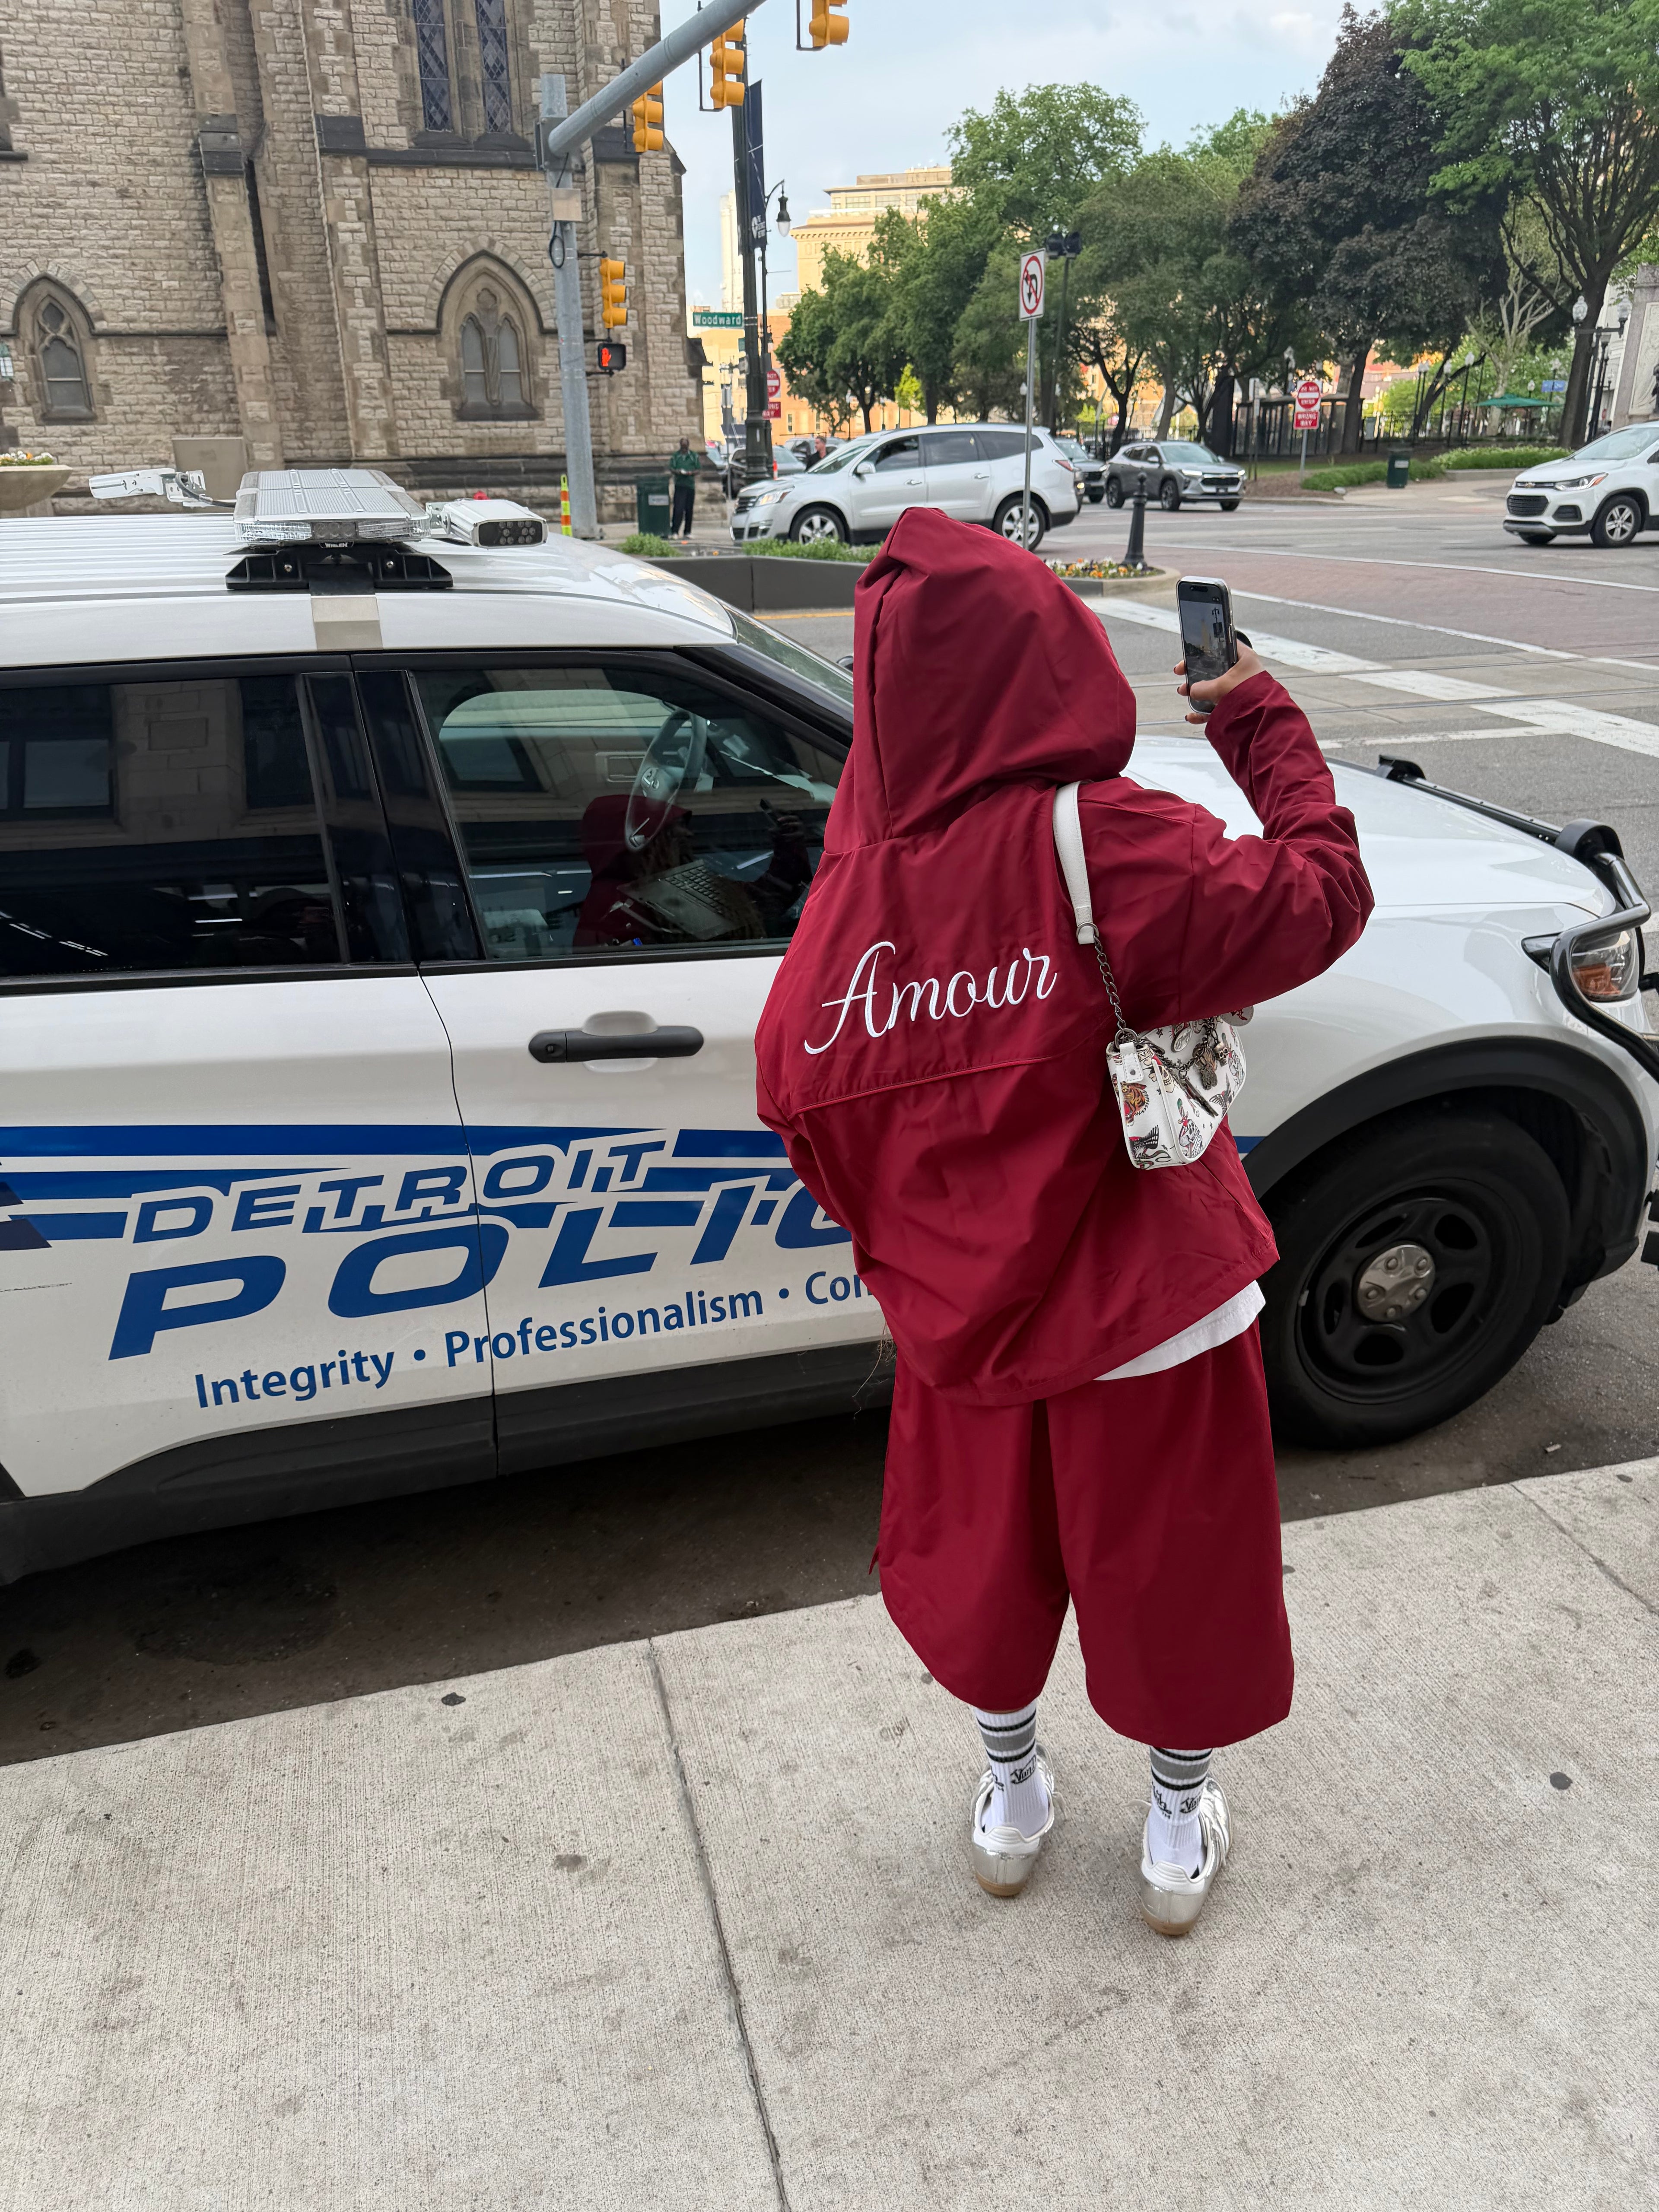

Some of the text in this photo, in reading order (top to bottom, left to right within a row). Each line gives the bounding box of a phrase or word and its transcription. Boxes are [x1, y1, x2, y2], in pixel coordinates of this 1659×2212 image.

[694, 314, 741, 325] Woodward
[804, 941, 1057, 1055] Amour
[133, 1140, 667, 1243] DETROIT
[195, 1349, 394, 1408] Integrity
[445, 1290, 763, 1367] Professionalism
